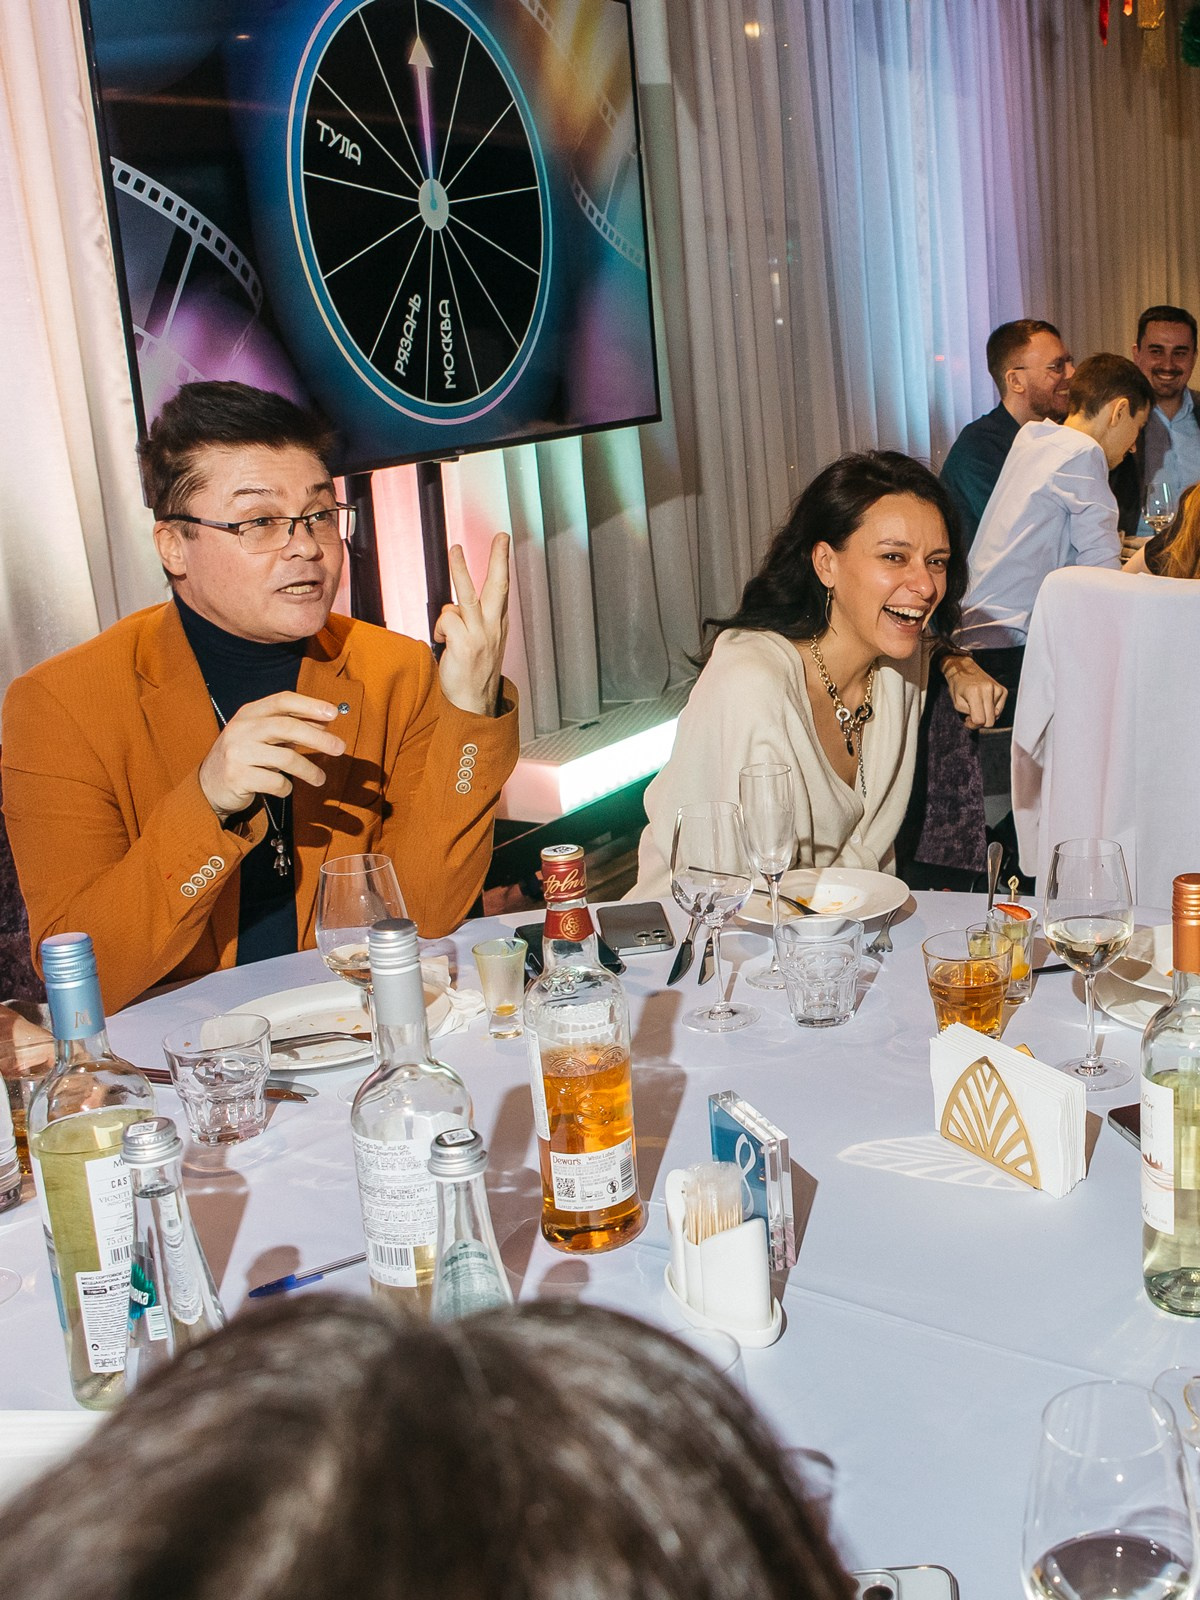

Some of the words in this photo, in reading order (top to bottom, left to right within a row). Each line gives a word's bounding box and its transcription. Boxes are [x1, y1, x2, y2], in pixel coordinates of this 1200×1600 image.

[315, 118, 363, 167] ТУЛА
[394, 292, 422, 377] РЯЗАНЬ
[438, 298, 457, 390] МОСКВА
